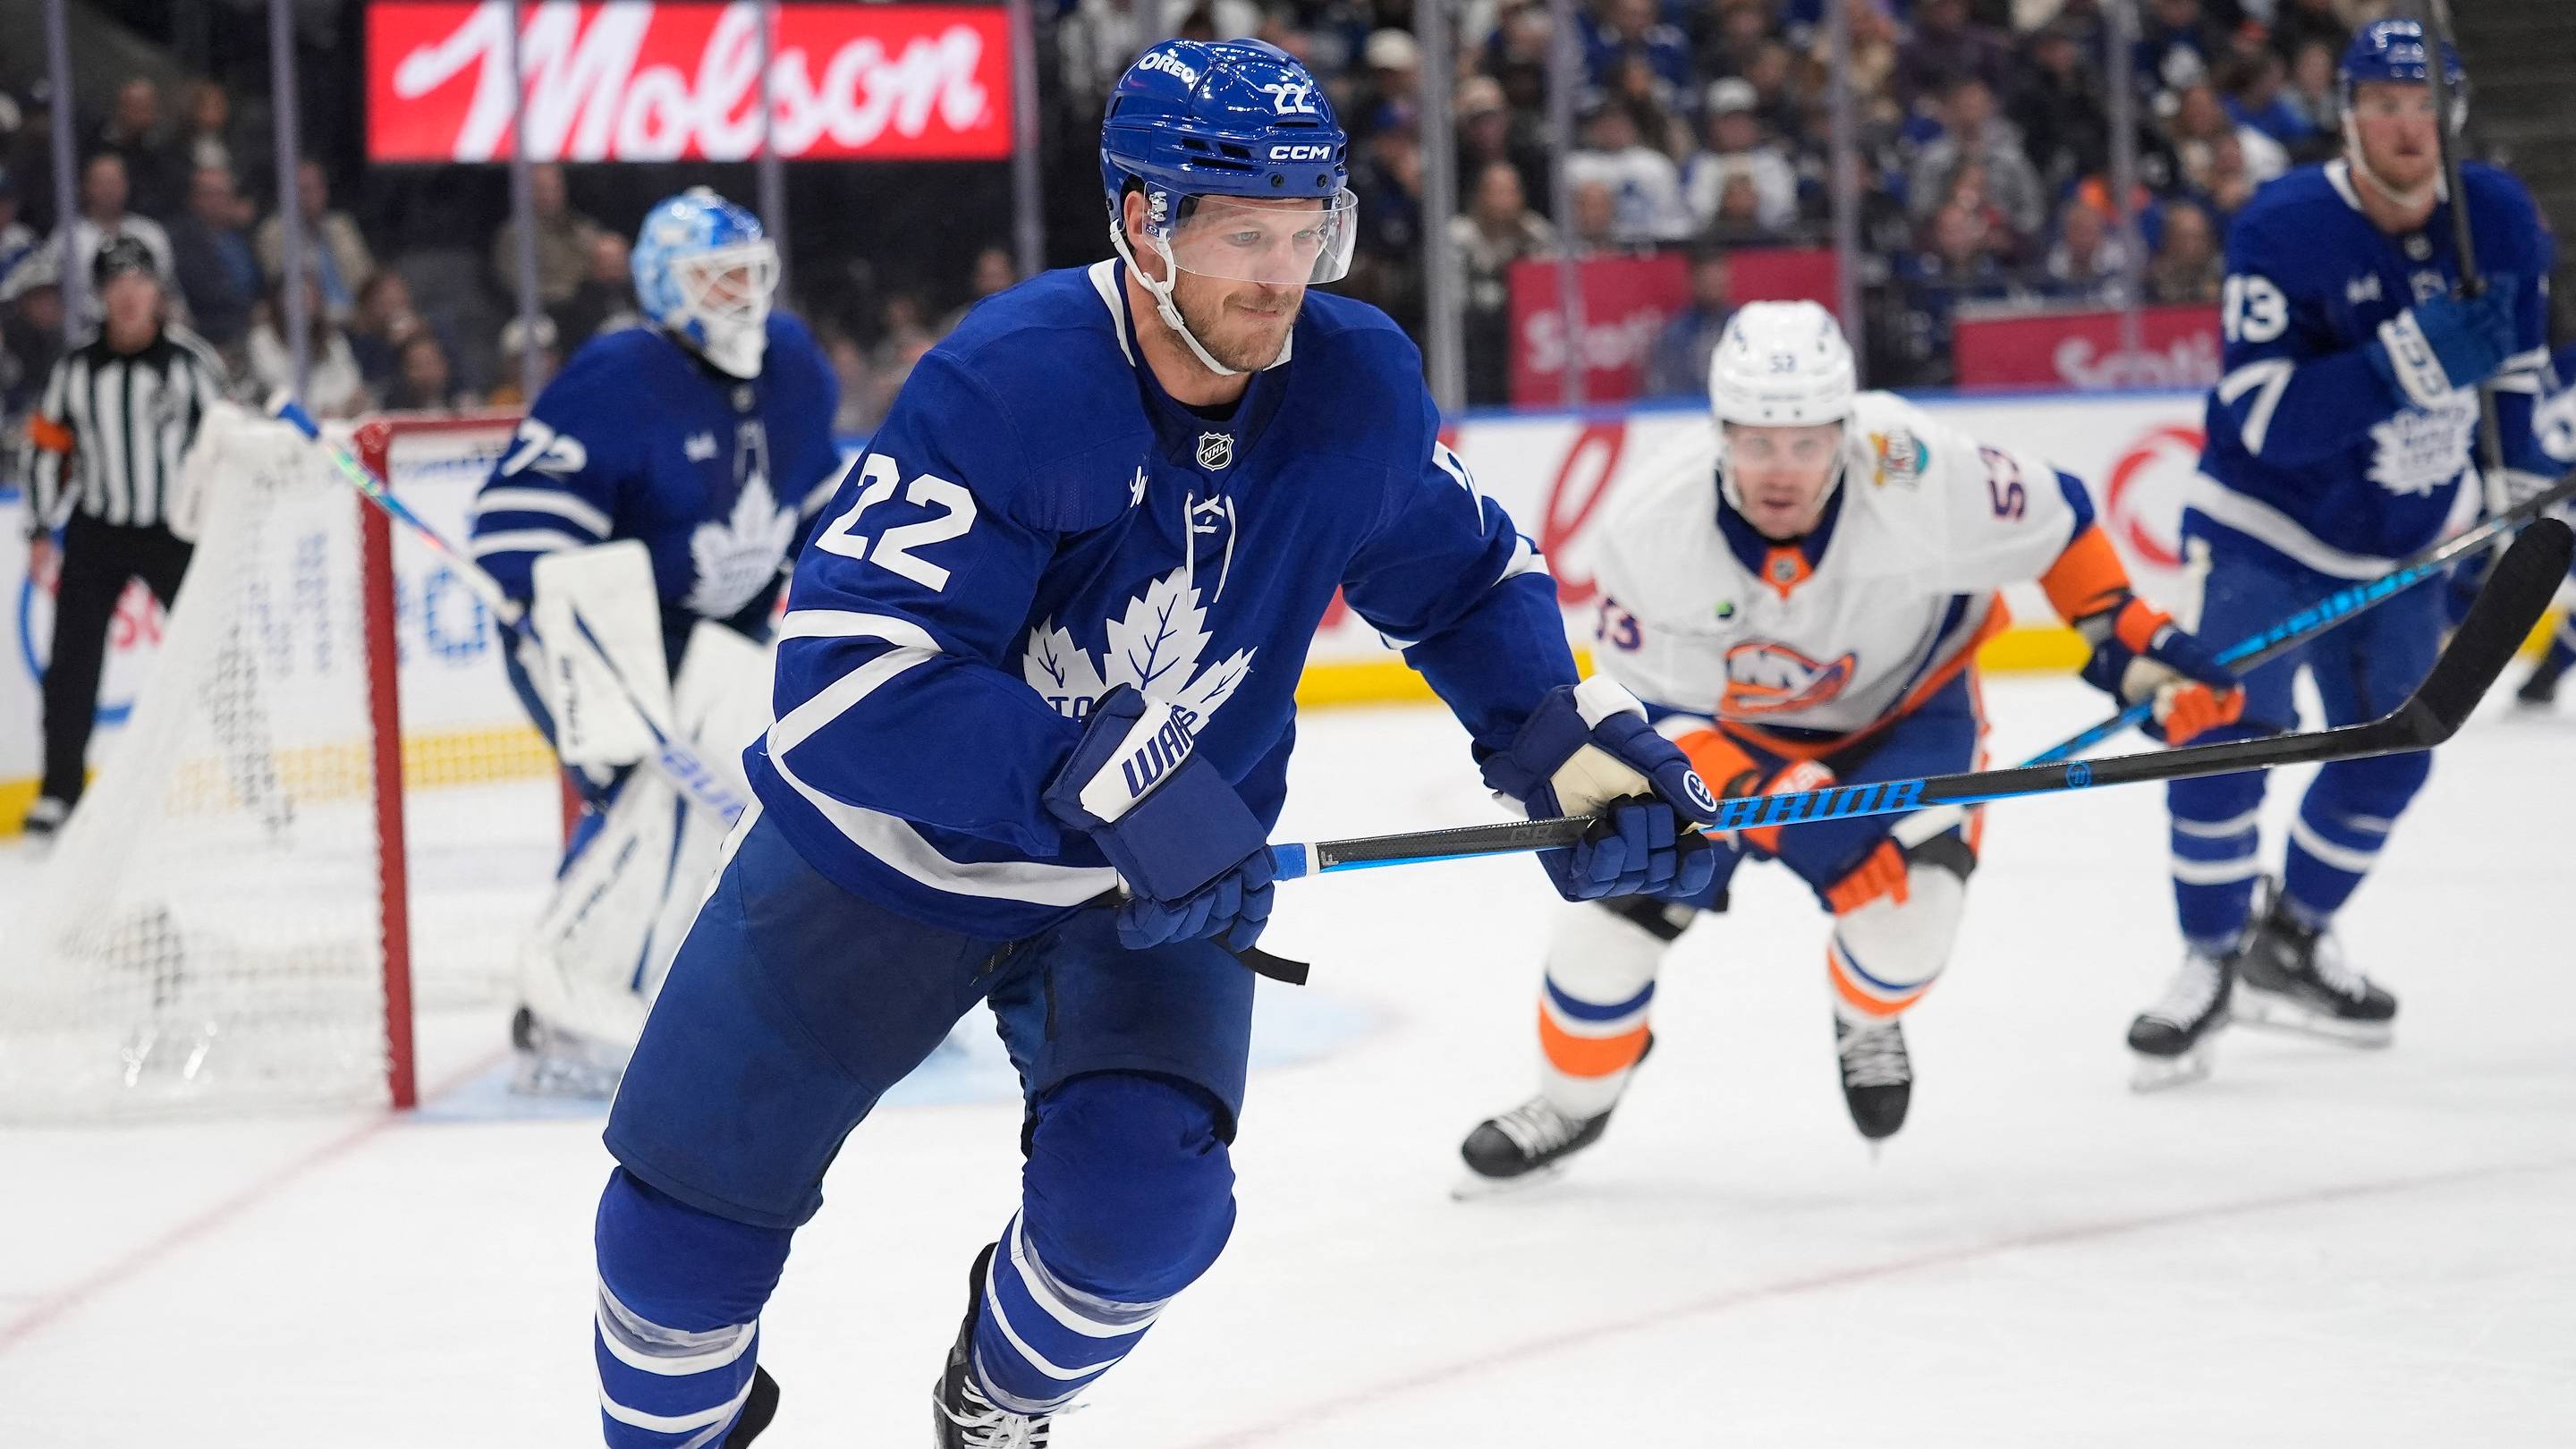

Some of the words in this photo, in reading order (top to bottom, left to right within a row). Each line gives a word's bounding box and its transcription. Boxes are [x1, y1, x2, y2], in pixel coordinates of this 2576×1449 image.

[393, 0, 987, 162] Molson
[1138, 51, 1199, 85] OREO
[1264, 82, 1317, 115] 22
[1269, 145, 1332, 161] CCM
[1203, 443, 1227, 462] NHL
[815, 453, 978, 593] 22
